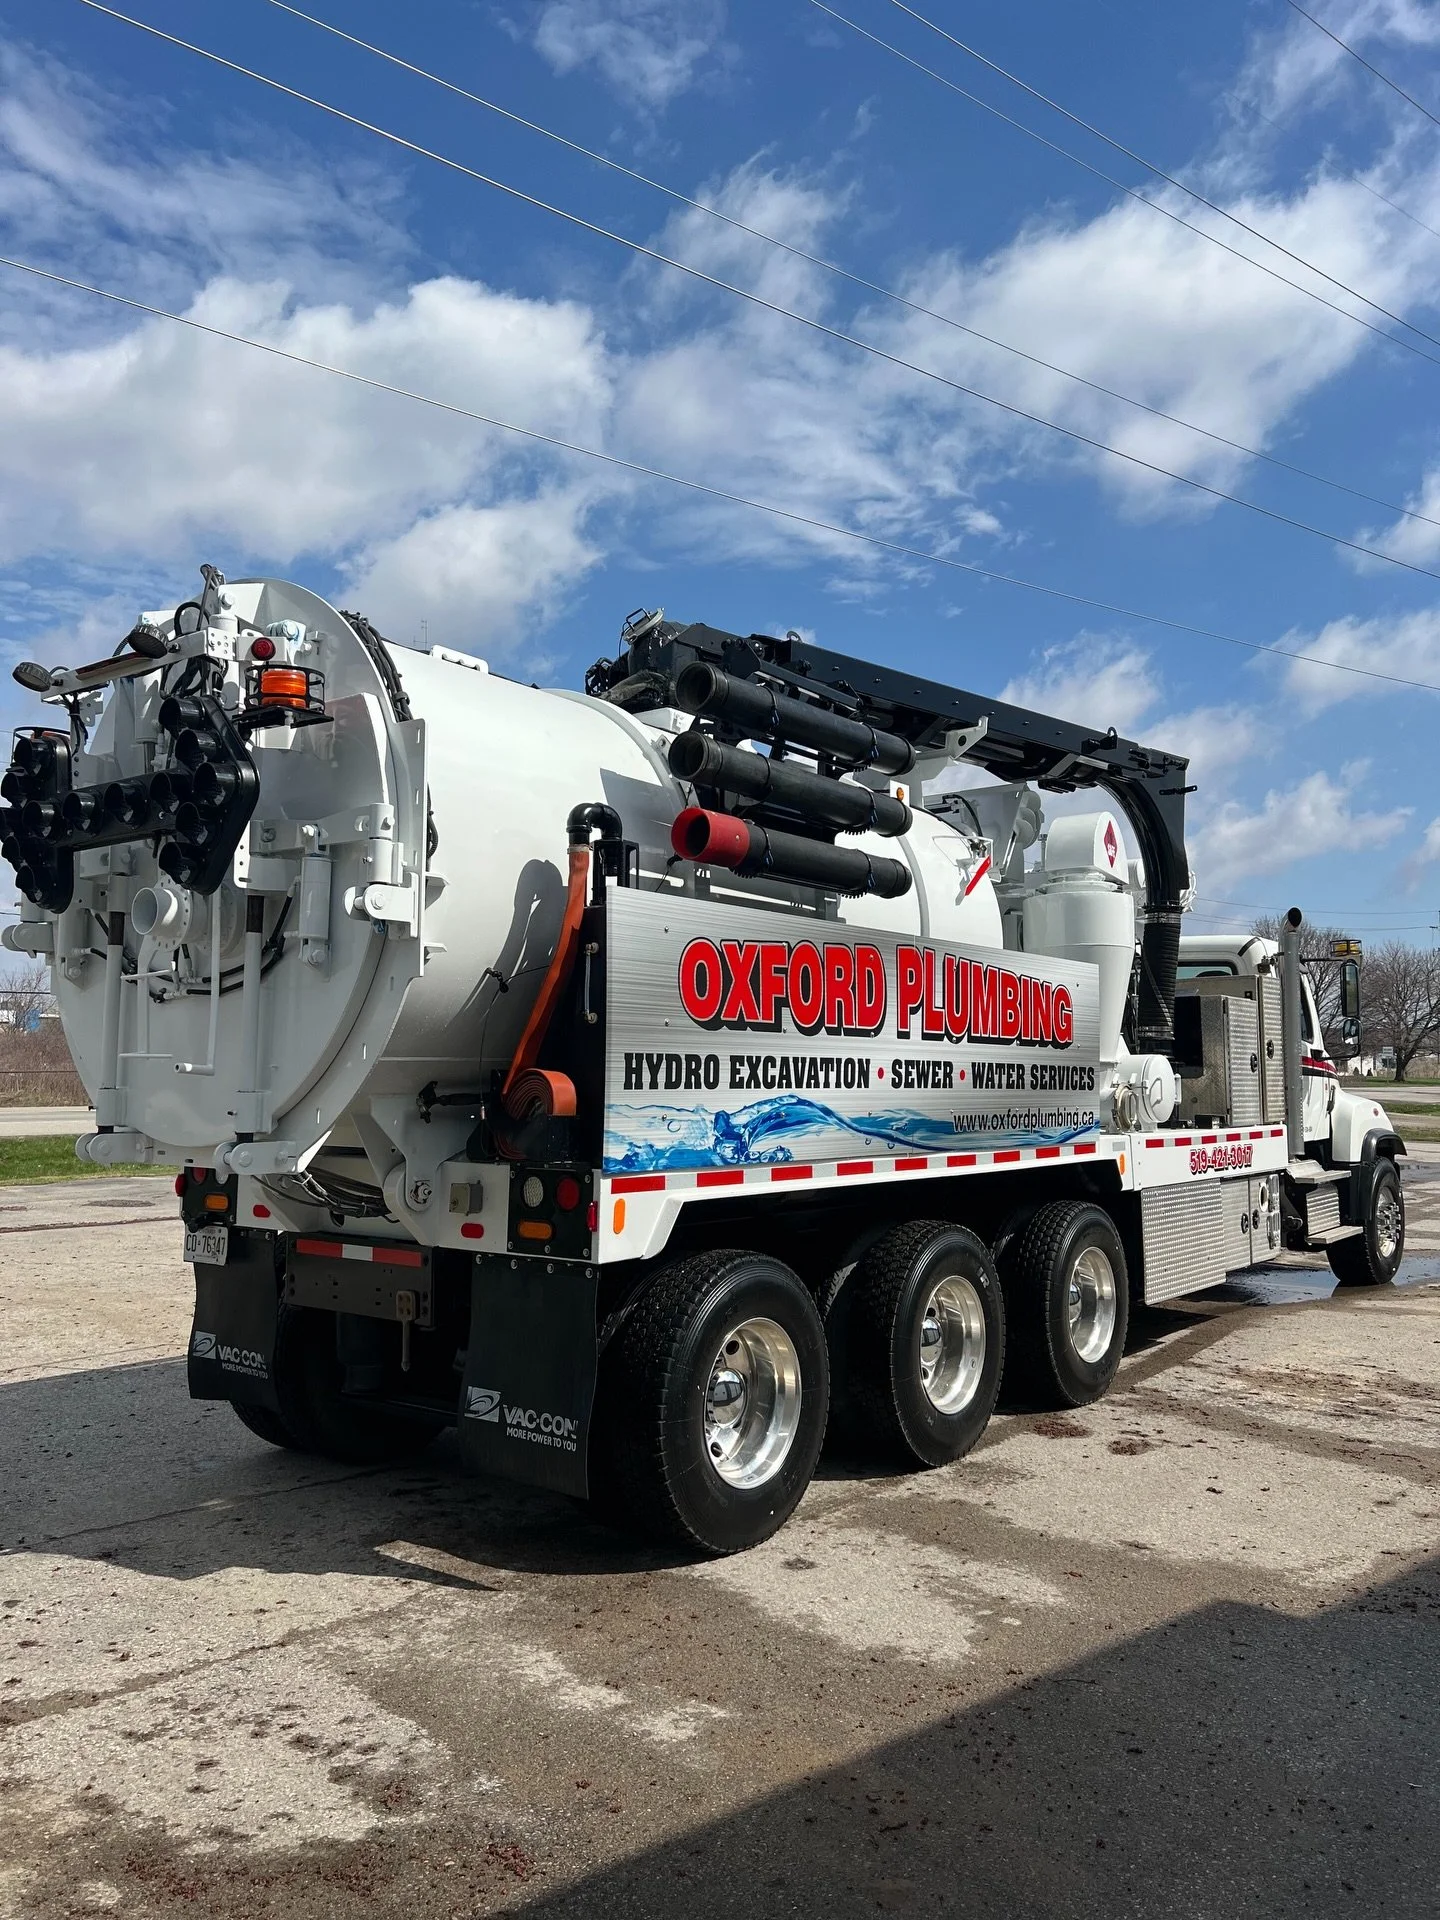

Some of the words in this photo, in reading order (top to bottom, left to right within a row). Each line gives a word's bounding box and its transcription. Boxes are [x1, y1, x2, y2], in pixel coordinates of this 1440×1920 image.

[678, 937, 888, 1038] OXFORD
[896, 944, 1074, 1050] PLUMBING
[623, 1052, 720, 1091] HYDRO
[729, 1055, 871, 1090] EXCAVATION
[891, 1058, 954, 1089] SEWER
[971, 1062, 1026, 1090] WATER
[1030, 1064, 1095, 1091] SERVICES
[953, 1107, 1095, 1133] www.oxfordplumbing.ca
[1189, 1144, 1253, 1175] 519-421-3017
[506, 1427, 527, 1440] MORE
[527, 1431, 552, 1446] POWER
[552, 1437, 562, 1448] TO
[562, 1440, 577, 1452] YOU
